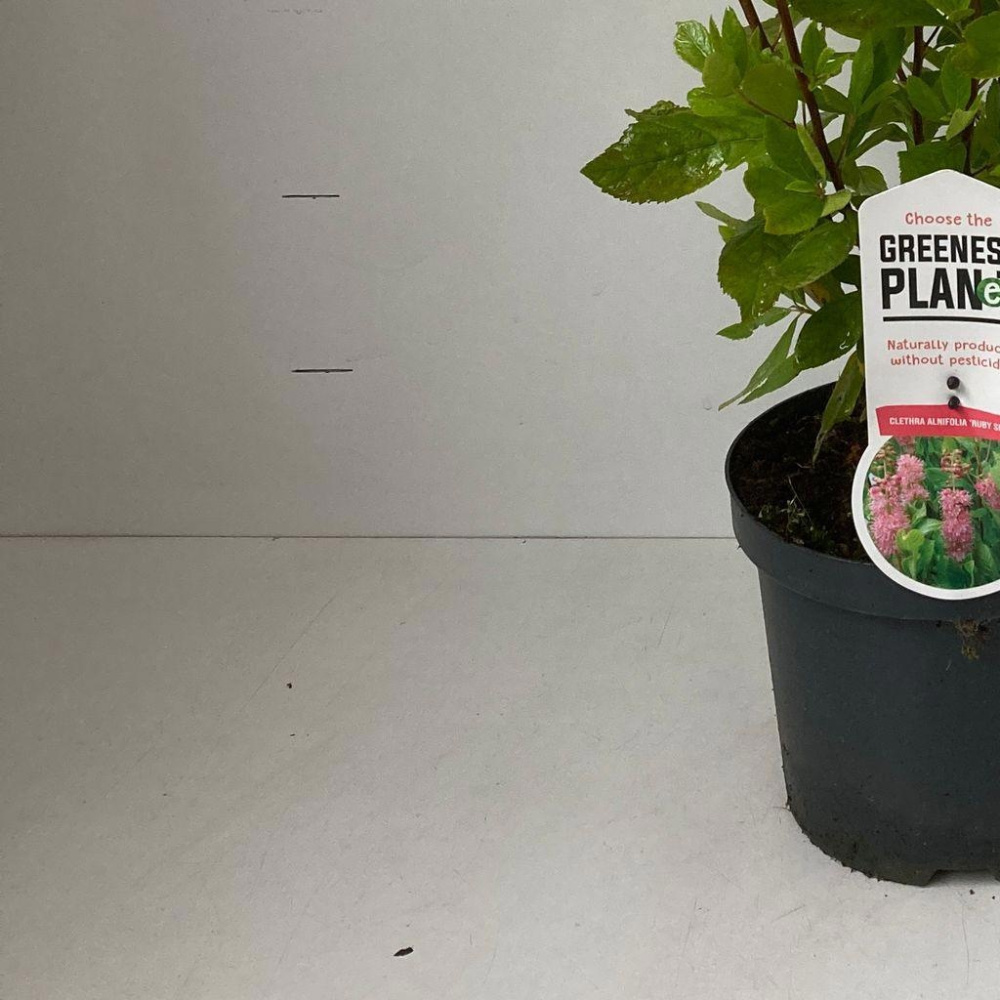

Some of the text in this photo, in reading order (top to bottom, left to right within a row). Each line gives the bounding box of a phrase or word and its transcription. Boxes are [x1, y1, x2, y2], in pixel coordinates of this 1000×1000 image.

[905, 212, 992, 227] Choose the
[887, 340, 949, 351] Naturally
[891, 354, 943, 366] without
[889, 417, 925, 425] CLETHRA
[927, 417, 968, 427] ALNIFOLIA
